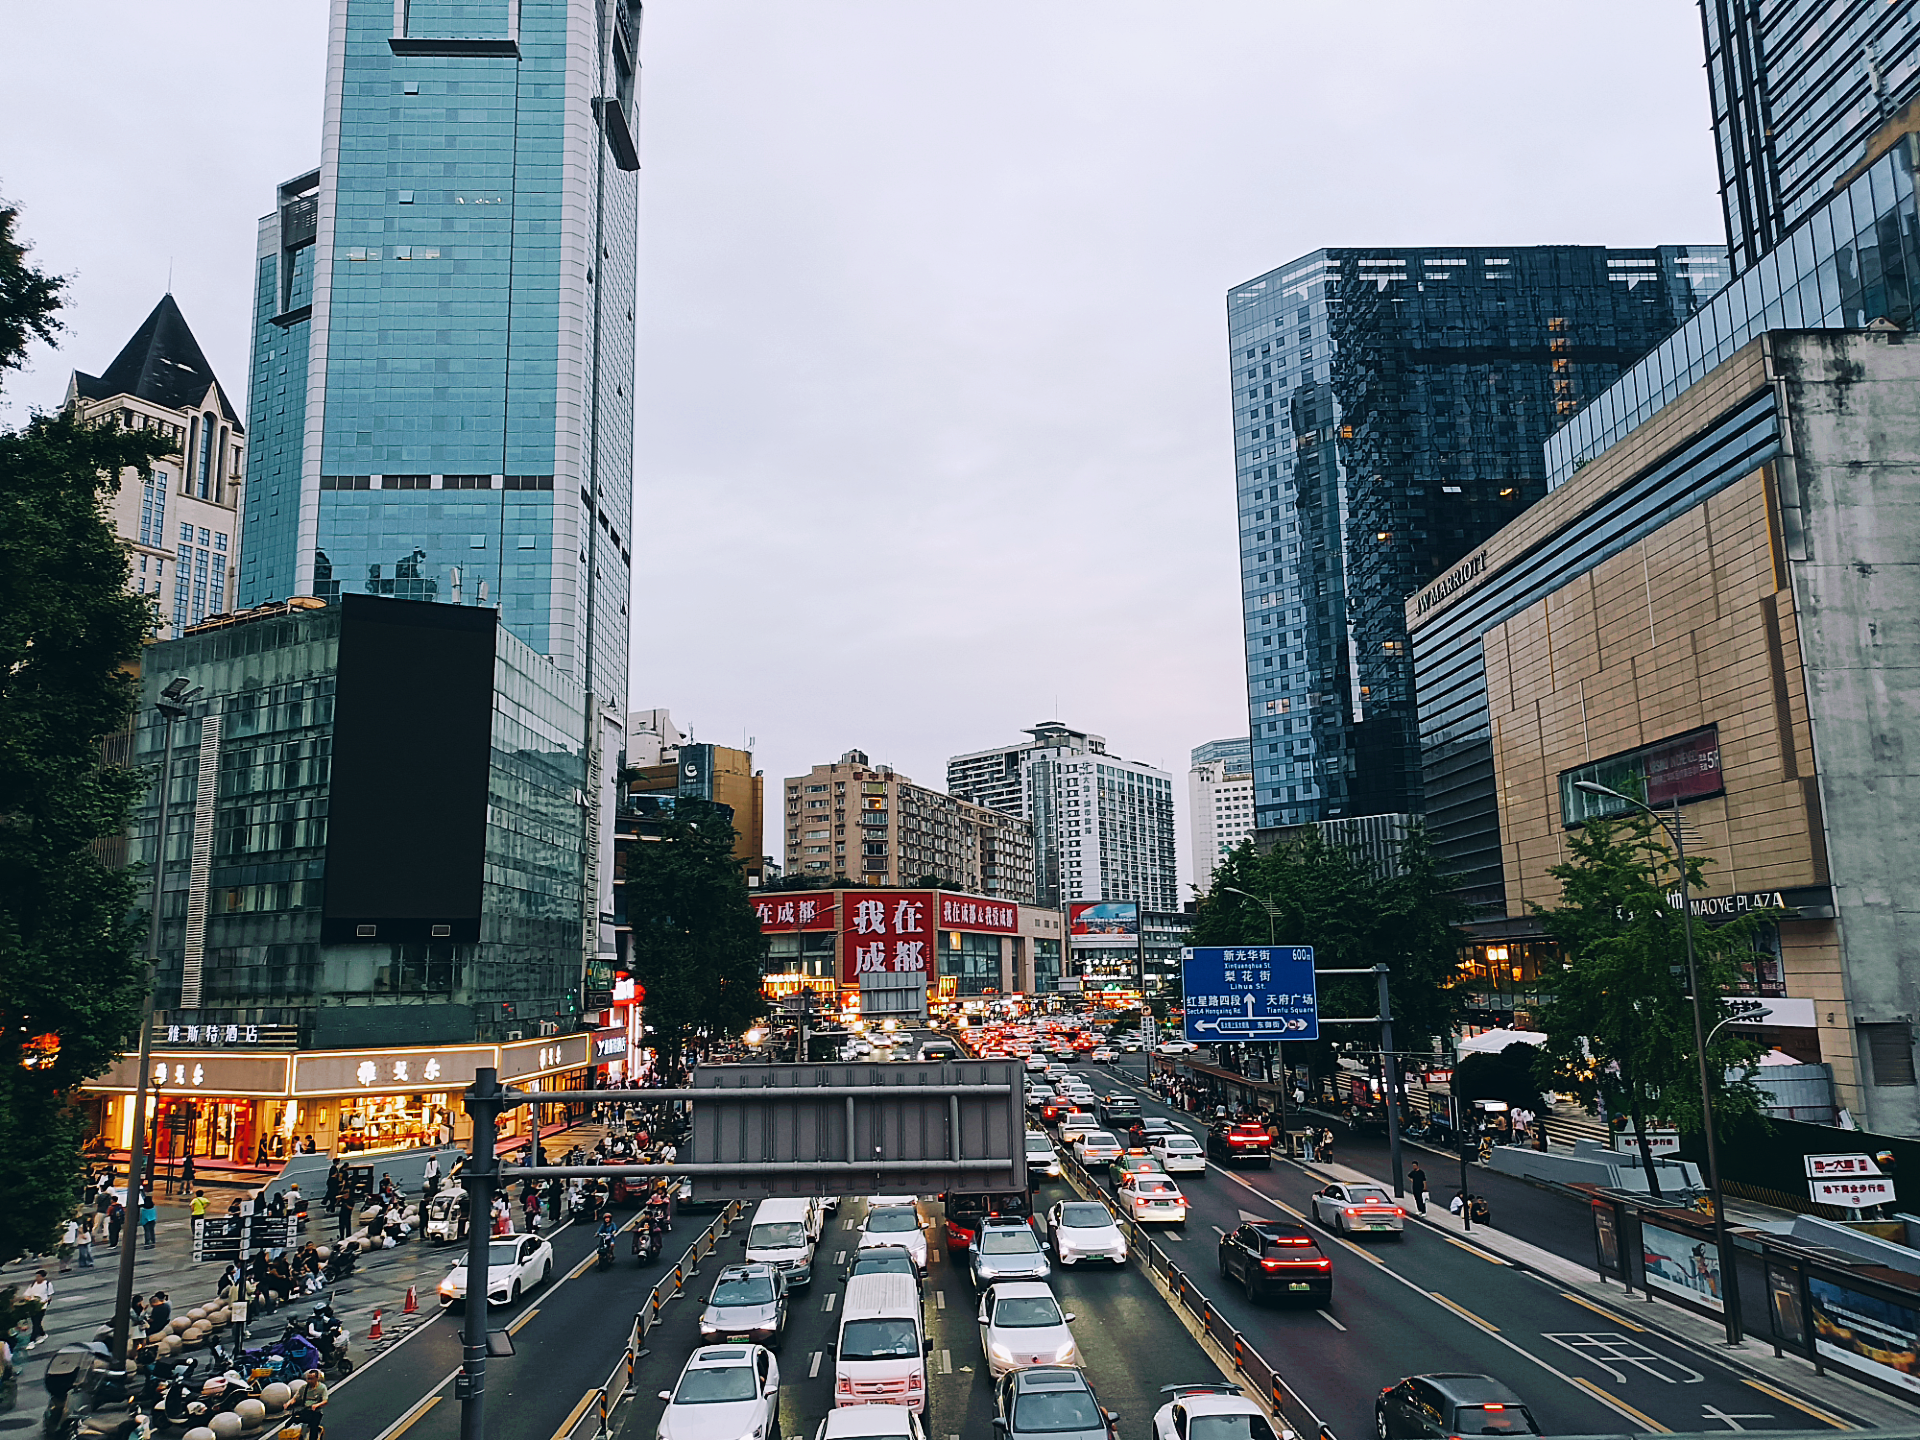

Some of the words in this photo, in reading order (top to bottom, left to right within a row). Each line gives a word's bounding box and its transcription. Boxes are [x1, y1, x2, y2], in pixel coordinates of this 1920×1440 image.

[1430, 550, 1487, 606] MARRIOTT
[1690, 896, 1735, 916] MAOYE
[1736, 892, 1785, 911] PLAZA
[853, 899, 924, 934] 我在
[853, 941, 924, 976] 成都
[1223, 950, 1270, 961] 新光华街
[1225, 970, 1270, 982] 梨花街
[1186, 995, 1241, 1007] 红星路四段
[1266, 994, 1313, 1006] 天府广场
[1206, 1007, 1232, 1016] Hongxing
[168, 1025, 258, 1043] 雅斯特酒店
[1823, 1184, 1885, 1194] 地下商业步行街
